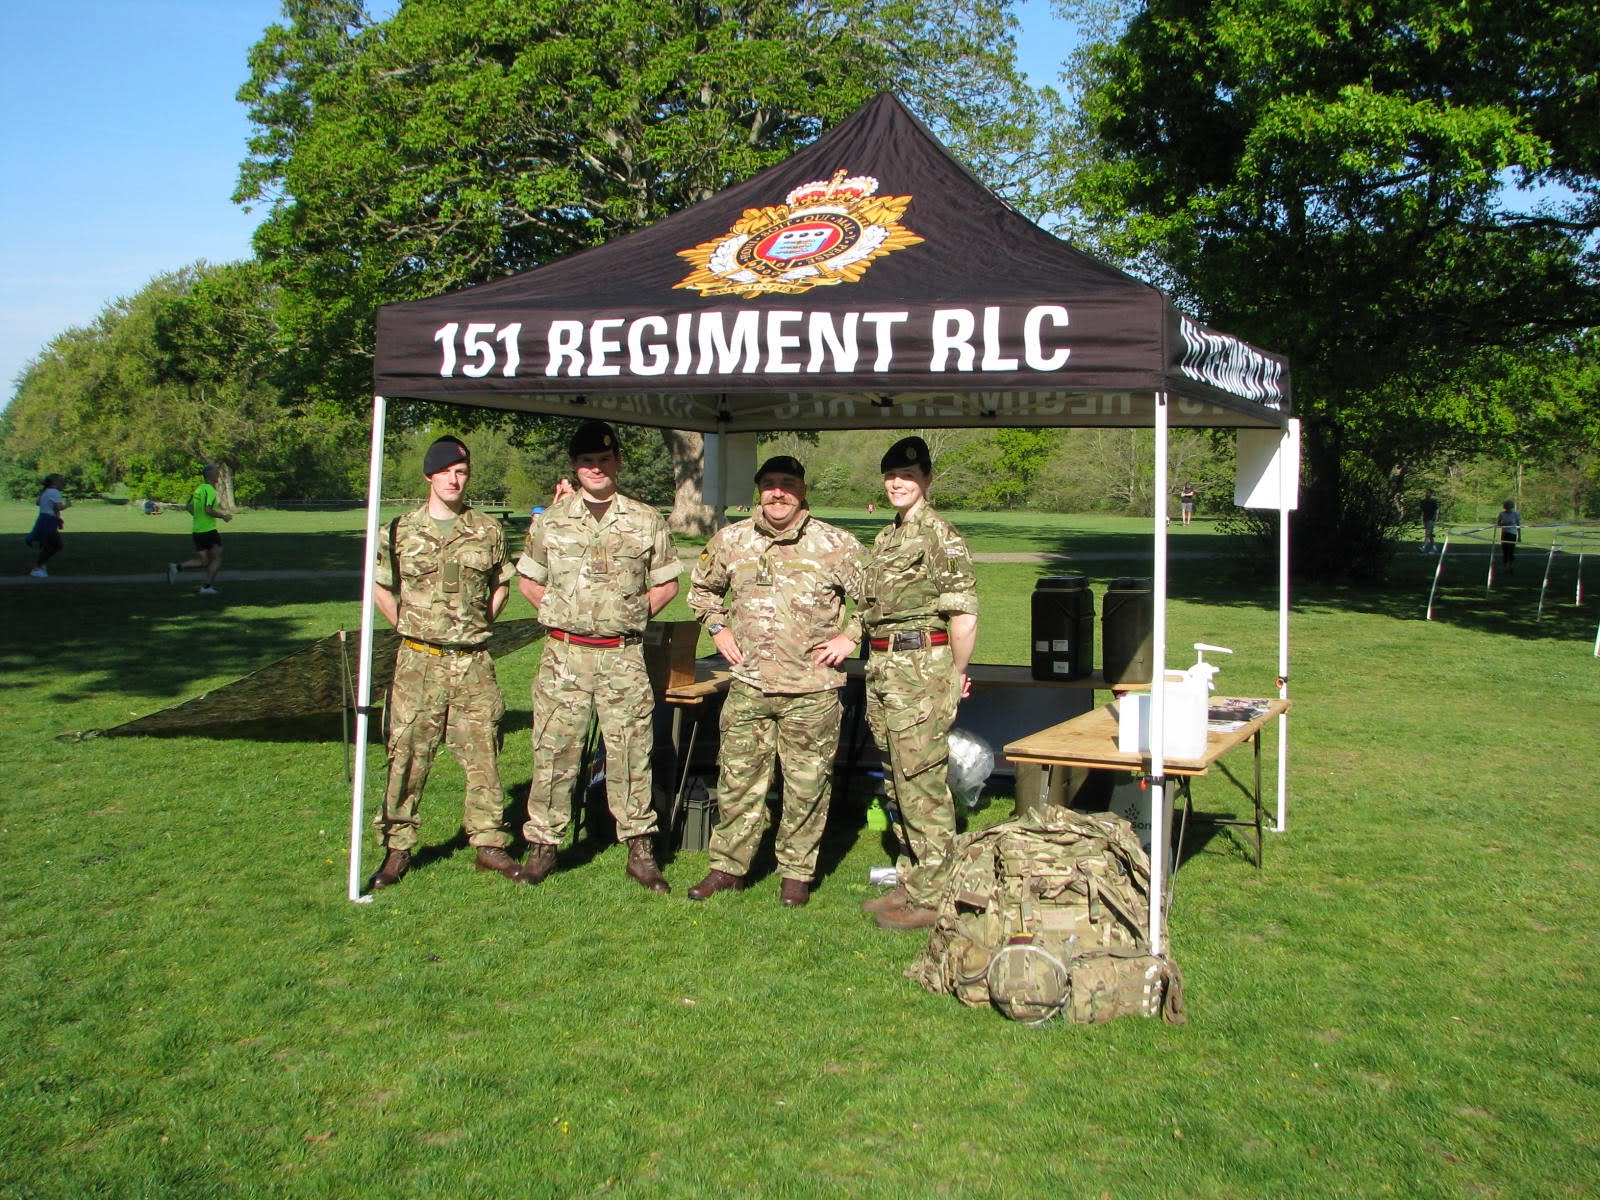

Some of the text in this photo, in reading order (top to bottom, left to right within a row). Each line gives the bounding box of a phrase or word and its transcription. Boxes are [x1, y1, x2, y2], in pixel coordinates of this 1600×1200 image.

[761, 219, 793, 238] SOIT
[803, 213, 831, 223] QUI
[434, 305, 1071, 377] 151 REGIMENT RLC
